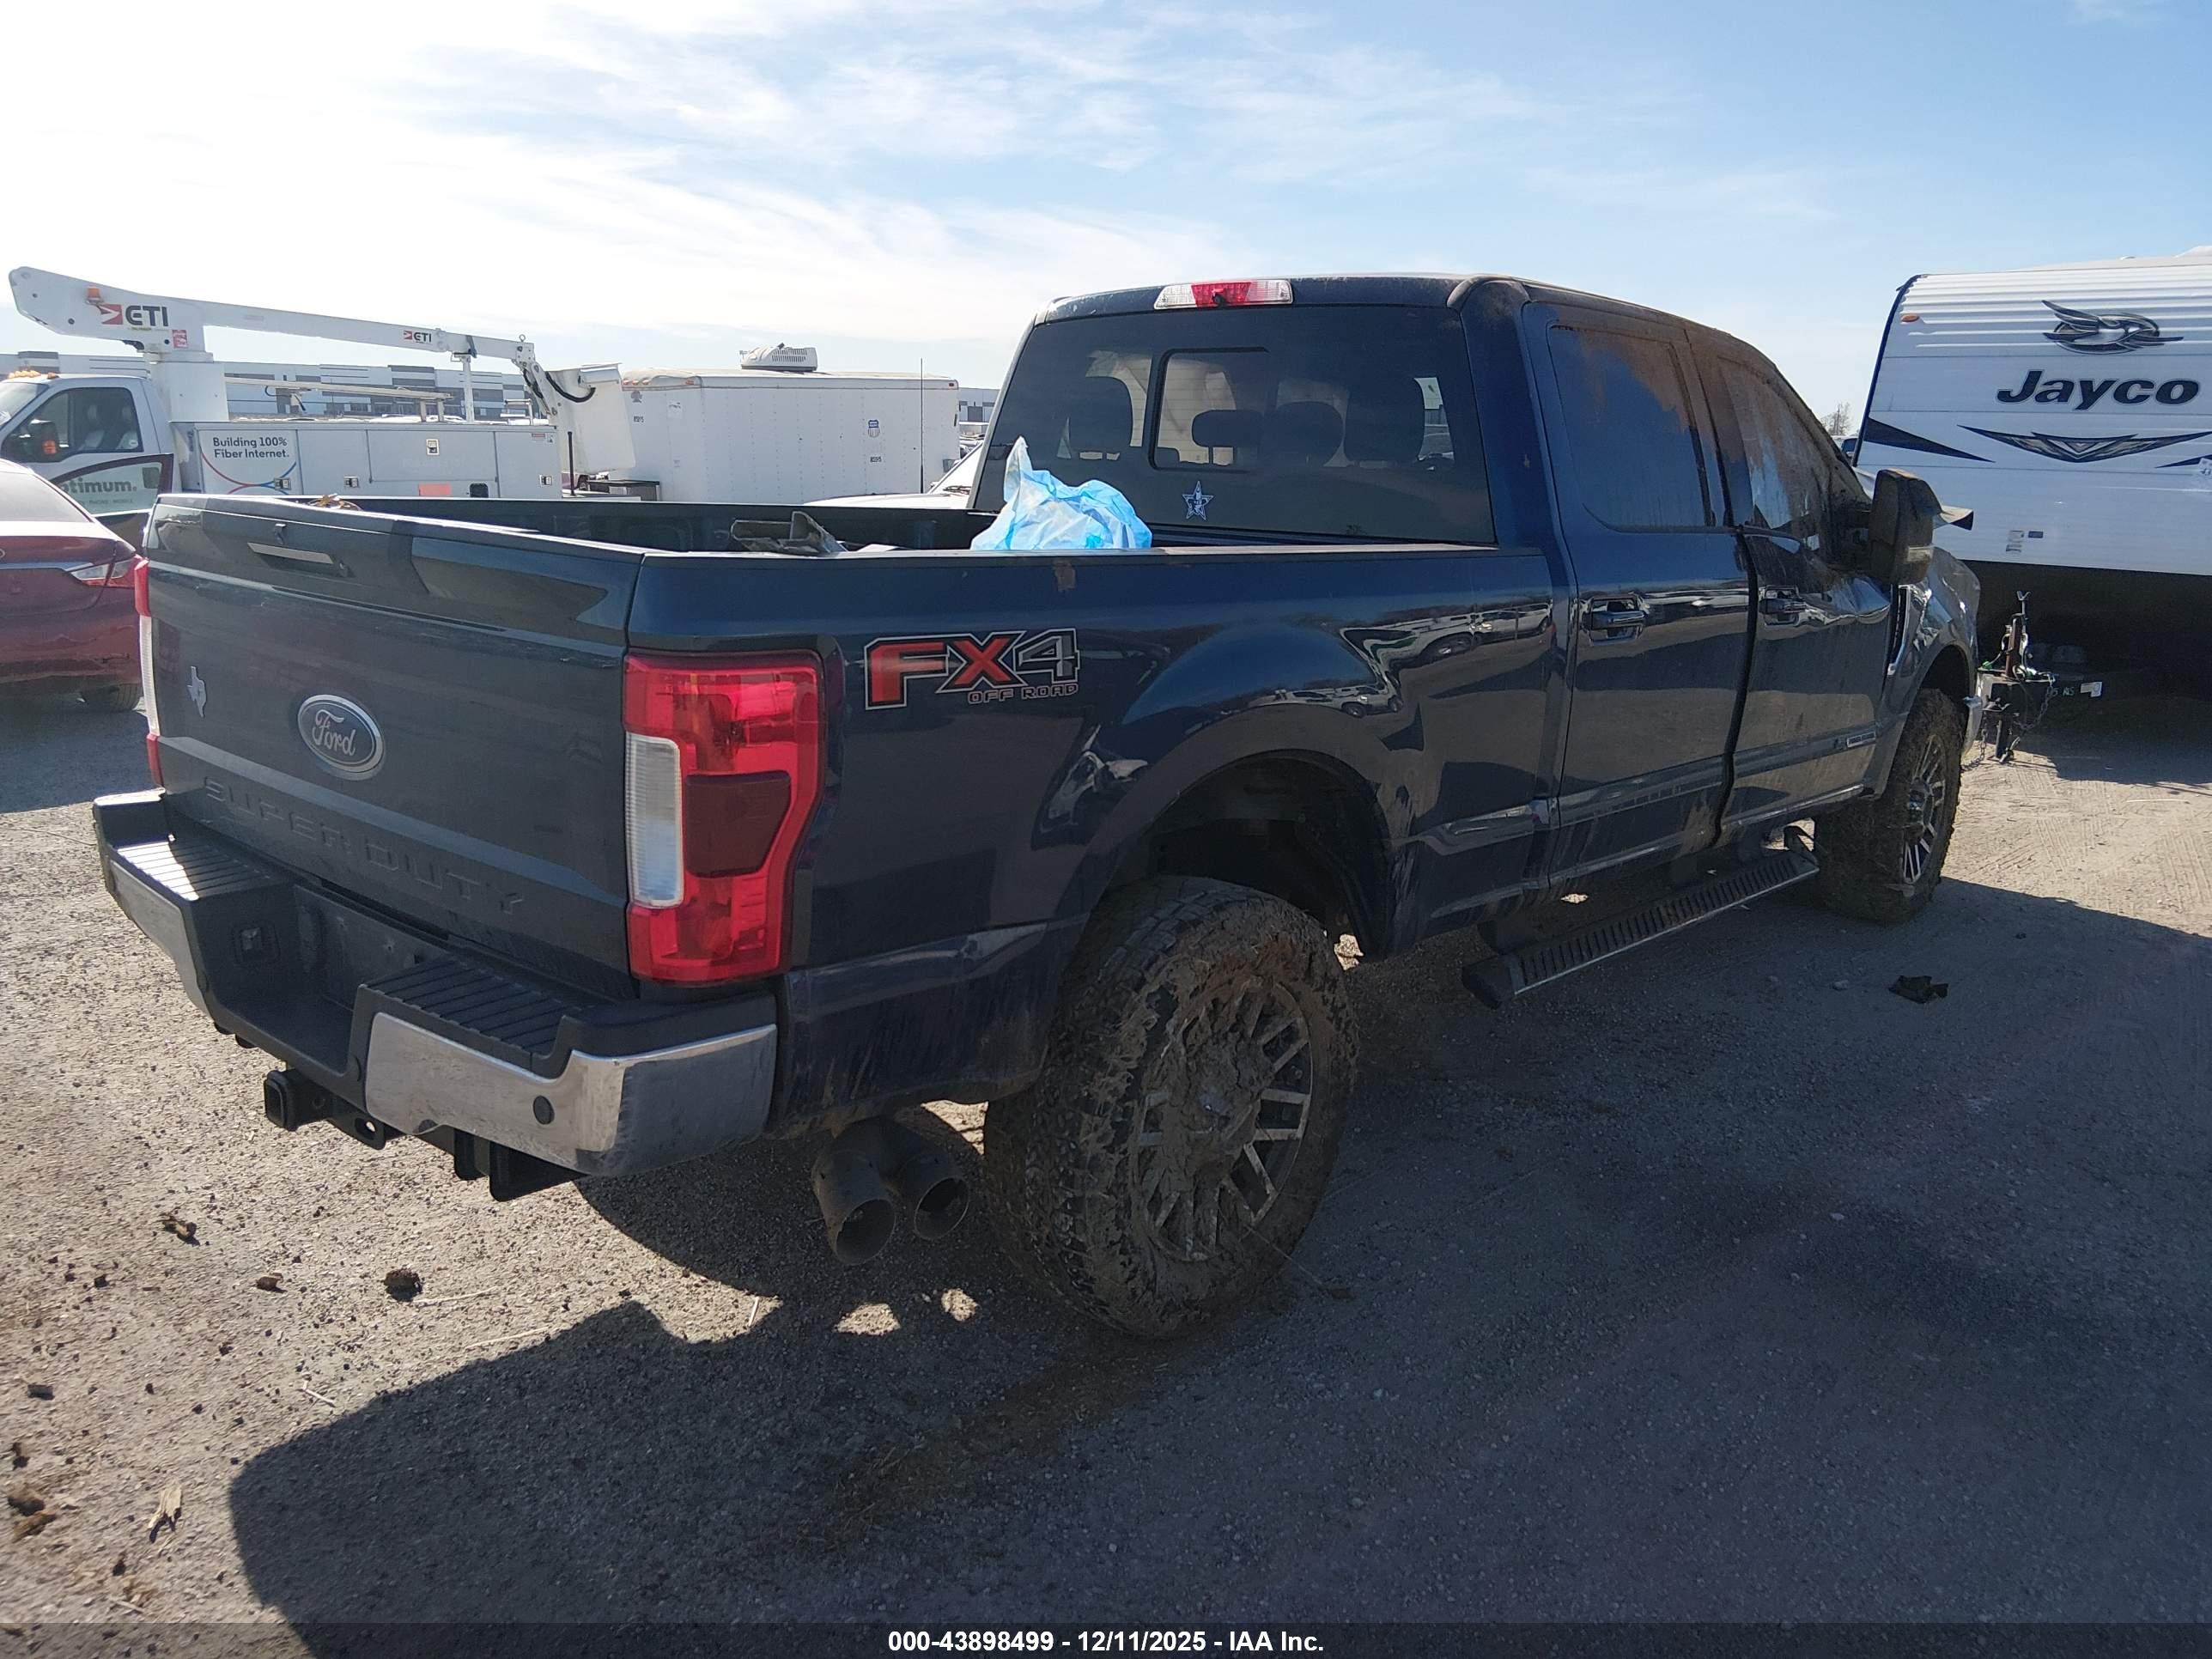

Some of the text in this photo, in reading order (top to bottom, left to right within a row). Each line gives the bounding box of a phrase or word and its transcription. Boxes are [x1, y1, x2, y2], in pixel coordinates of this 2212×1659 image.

[125, 305, 169, 327] ETI
[413, 331, 432, 343] ETI
[1996, 369, 2201, 410] Jayco
[212, 436, 289, 448] Building 100%
[214, 448, 290, 459] Fiber Internet.
[865, 629, 1080, 710] FX4
[968, 683, 1079, 704] OFF ROAD
[312, 708, 356, 757] Ford
[204, 775, 524, 916] SUPER DUTY
